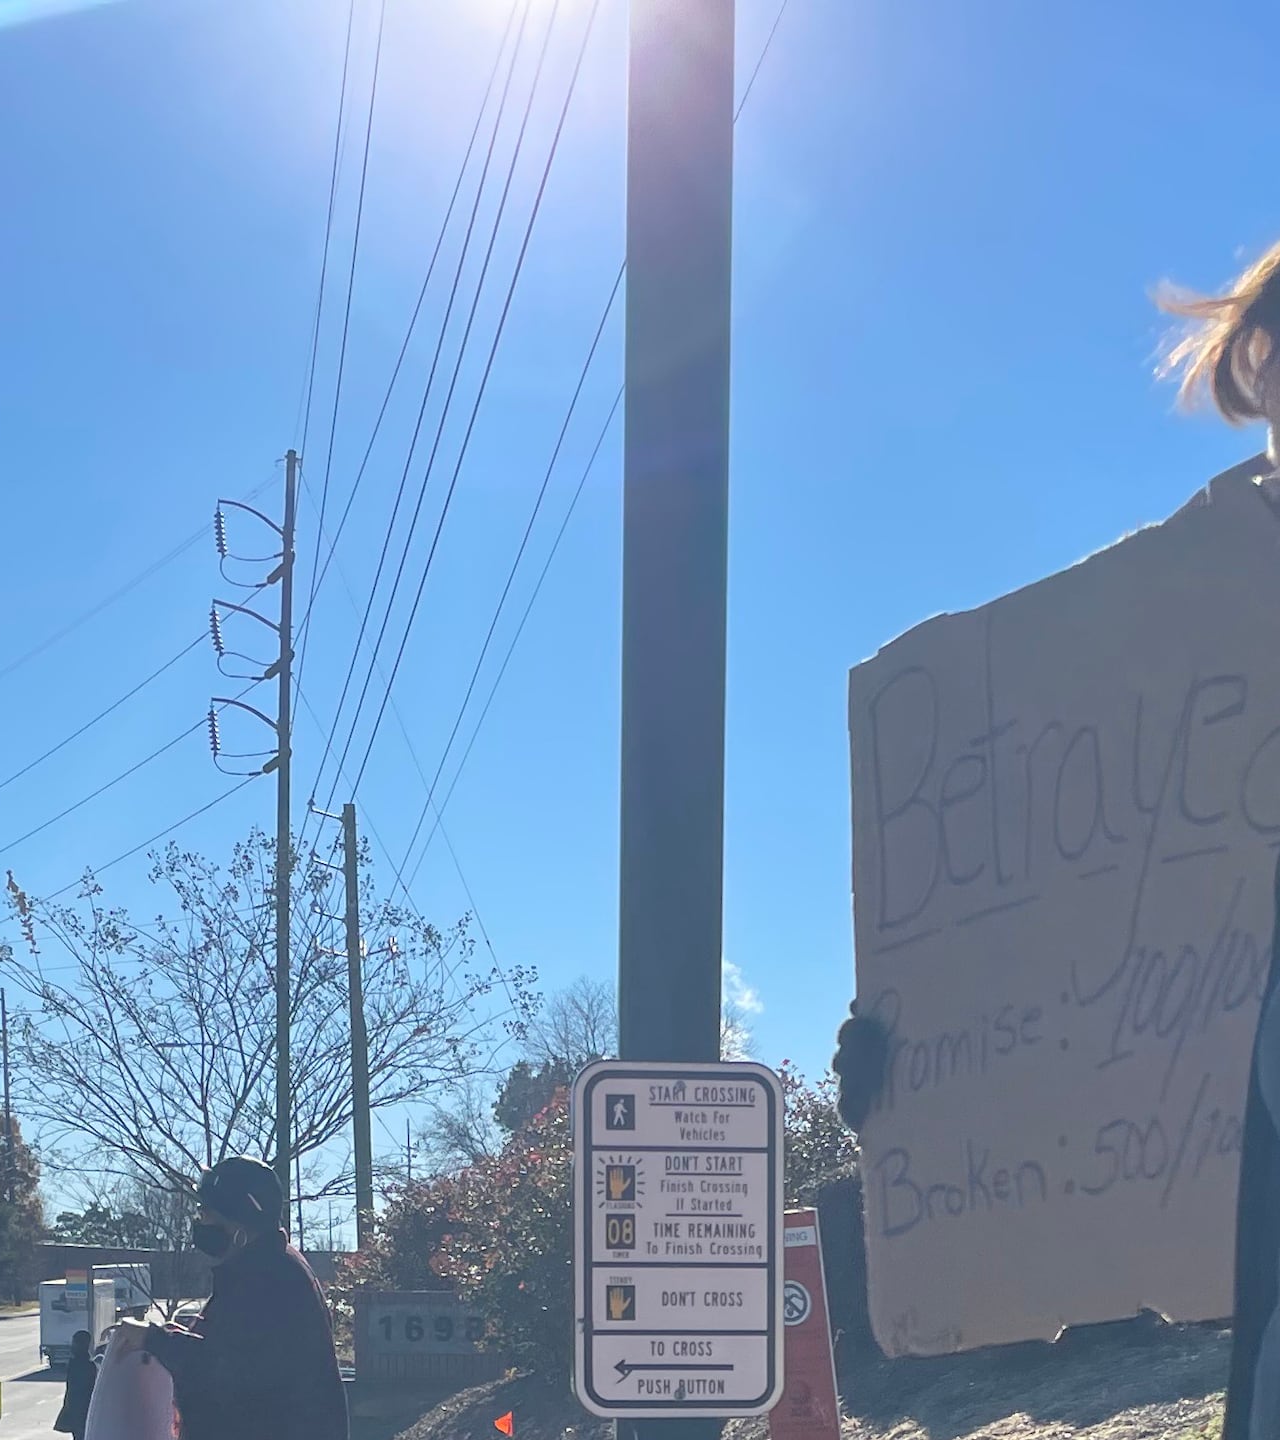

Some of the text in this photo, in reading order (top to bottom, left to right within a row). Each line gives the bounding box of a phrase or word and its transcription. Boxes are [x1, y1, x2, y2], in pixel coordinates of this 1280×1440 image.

[649, 1085, 756, 1103] START CROSSING
[674, 1110, 730, 1124] Watch For
[679, 1126, 726, 1141] Vehicles
[665, 1155, 743, 1172] DON'T START
[660, 1179, 749, 1198] Finish Crossing
[690, 1197, 733, 1212] Started
[608, 1219, 634, 1245] 08
[653, 1222, 756, 1239] TIME REMAINING
[646, 1241, 763, 1259] To Finish Crossing
[661, 1291, 744, 1308] DON'T CROSS
[650, 1341, 713, 1357] TO CROSS
[637, 1379, 725, 1395] PUSH BUTTON
